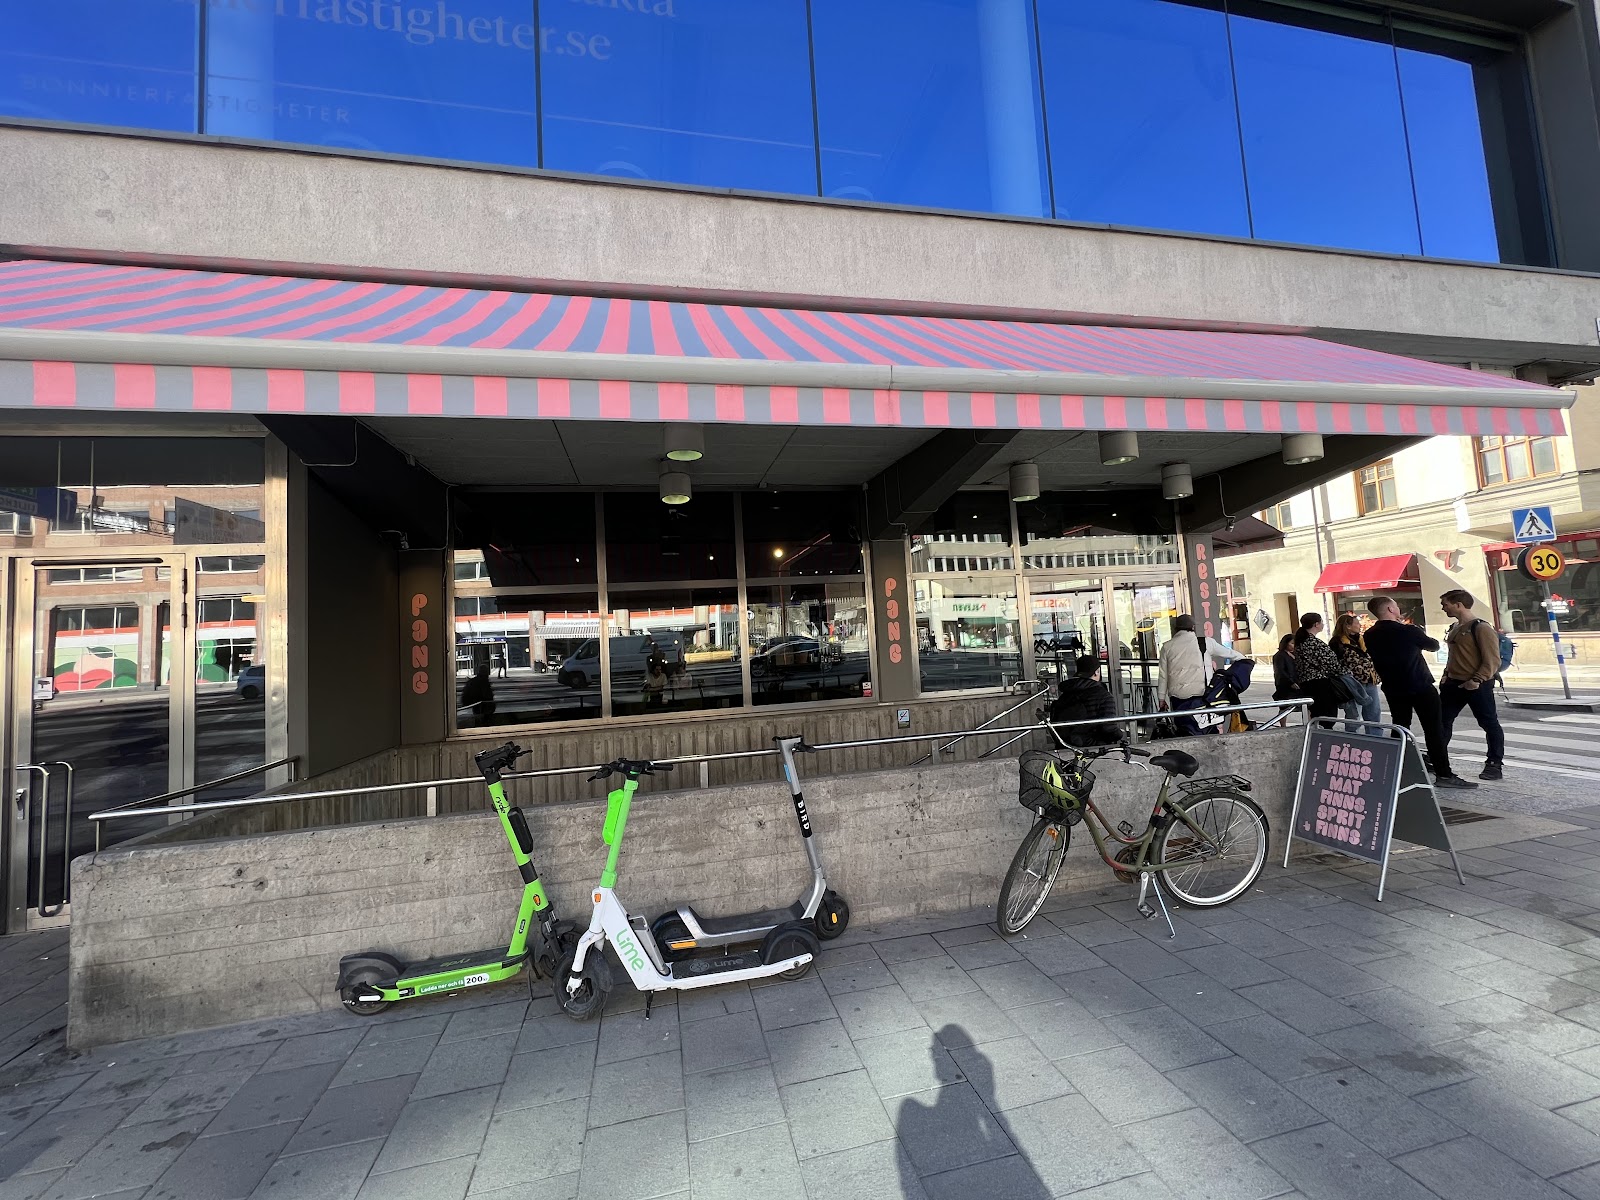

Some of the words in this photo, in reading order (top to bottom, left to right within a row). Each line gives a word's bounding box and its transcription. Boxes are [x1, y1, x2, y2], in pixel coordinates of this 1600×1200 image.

[1532, 553, 1559, 572] 30
[1329, 743, 1373, 765] BÄRS
[1326, 759, 1374, 782] FINNS.
[1329, 775, 1362, 795] MAT
[1320, 789, 1367, 814] FINNS.
[797, 800, 810, 830] BIRD
[1317, 804, 1365, 829] SPRIT
[1315, 819, 1362, 846] FINNS.
[615, 928, 645, 972] Lime
[420, 985, 438, 993] Ladda
[466, 975, 483, 984] 200
